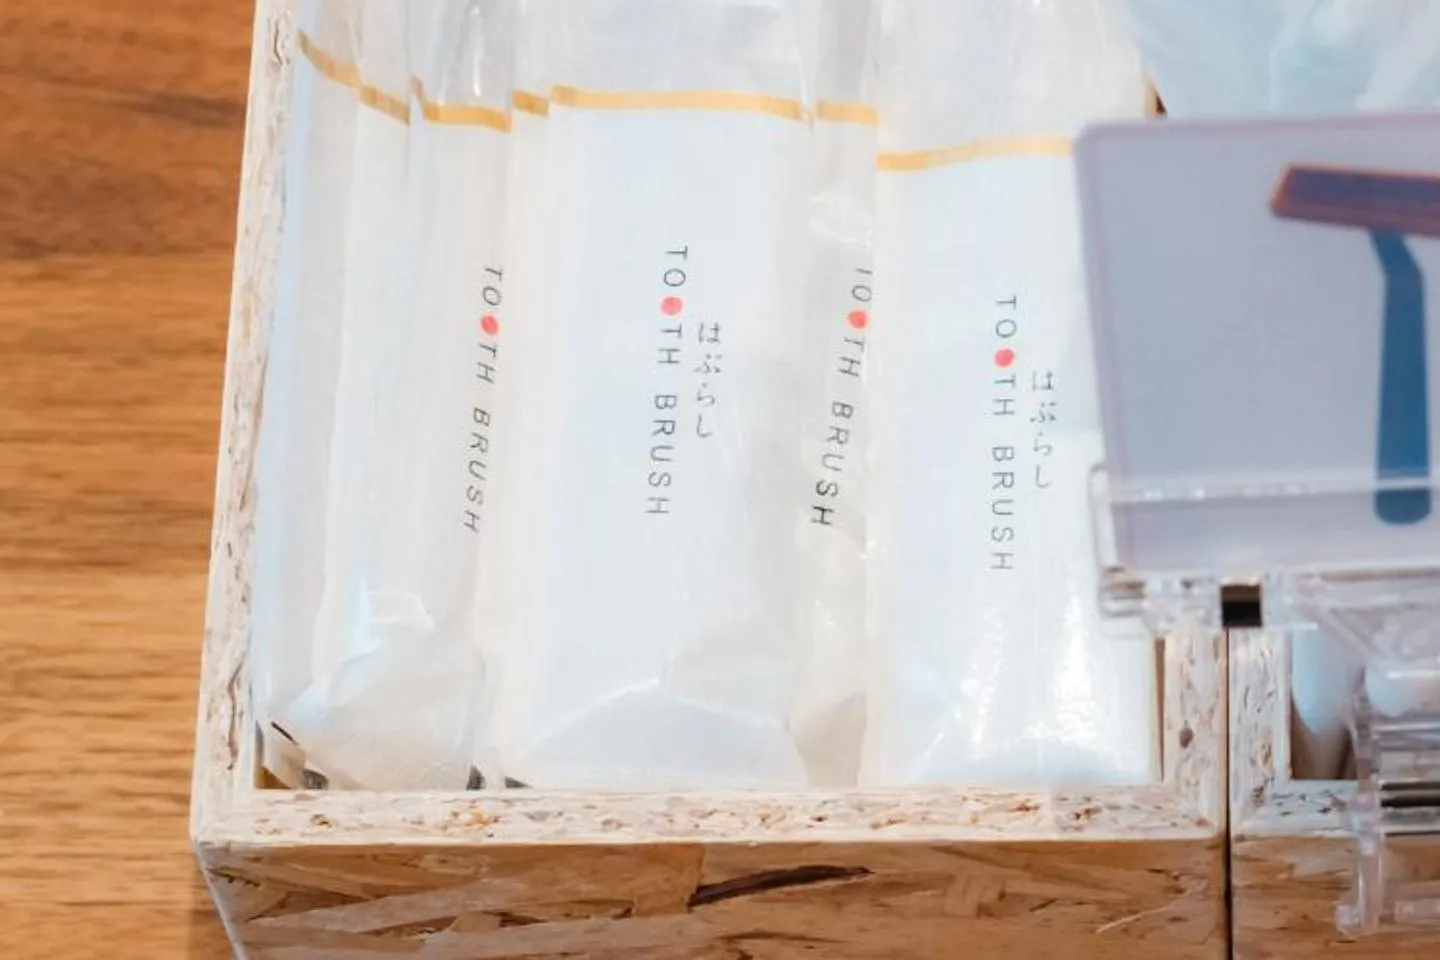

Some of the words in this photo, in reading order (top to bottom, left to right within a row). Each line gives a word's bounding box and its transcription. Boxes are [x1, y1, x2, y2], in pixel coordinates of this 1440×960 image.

[476, 266, 503, 384] TOOTH
[657, 246, 688, 365] TOOTH
[993, 294, 1018, 417] TOOTH
[463, 407, 491, 533] BRUSH
[646, 394, 678, 514] BRUSH
[810, 400, 854, 526] BRUSH
[989, 444, 1015, 571] BRUSH
